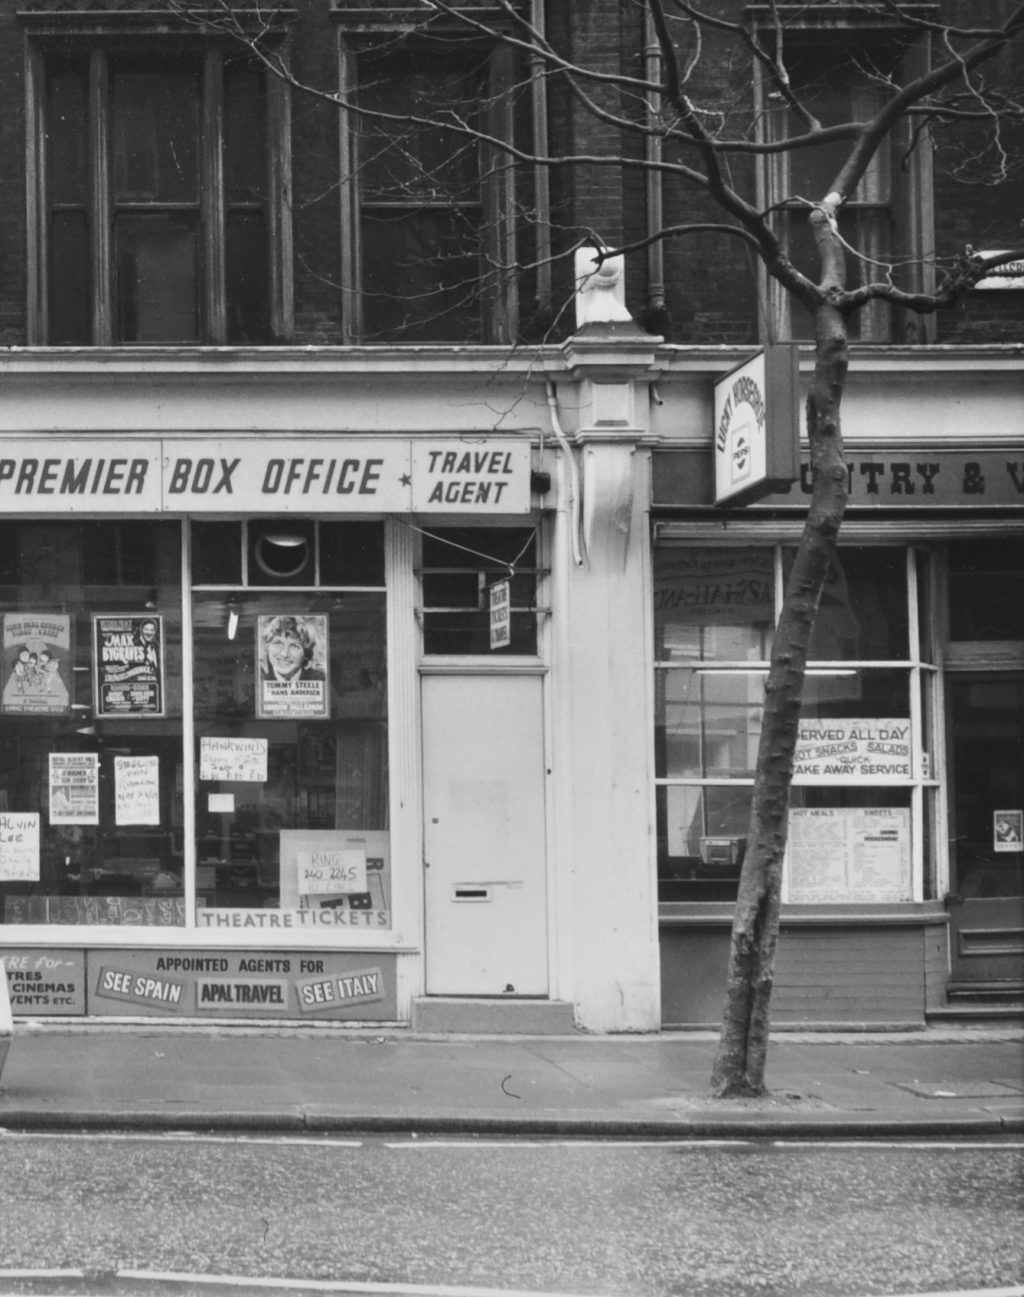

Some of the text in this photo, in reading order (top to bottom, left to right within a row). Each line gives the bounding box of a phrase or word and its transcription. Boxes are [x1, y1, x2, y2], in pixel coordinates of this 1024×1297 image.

[717, 392, 733, 454] LUCKY
[428, 451, 514, 474] TRAVEL
[168, 459, 242, 495] BOX
[261, 459, 385, 495] OFFICE
[962, 462, 985, 495] &
[428, 481, 508, 504] AGENT
[104, 633, 134, 647] MAX
[102, 646, 145, 664] BYGRAVES
[799, 726, 909, 741] ERVED ALL DAY
[201, 738, 266, 755] HAWKWIND
[815, 742, 858, 757] SNACKS
[867, 742, 909, 756] SALADS
[839, 755, 870, 764] QUICK
[823, 764, 856, 775] AWAY
[860, 764, 910, 775] SERVICE
[311, 852, 342, 867] RING
[201, 910, 387, 928] THEATRE TICKETS
[2, 956, 28, 969] ERE
[156, 957, 324, 974] APPOINTED AGENTS FOR
[6, 971, 43, 981] TRES
[12, 983, 76, 994] CINEMAS
[103, 970, 183, 1004] SEE SPAIN
[201, 983, 284, 1003] APAL TRAVEL
[302, 972, 379, 1005] SEE ITALY
[9, 994, 76, 1006] VENTS ETC.
